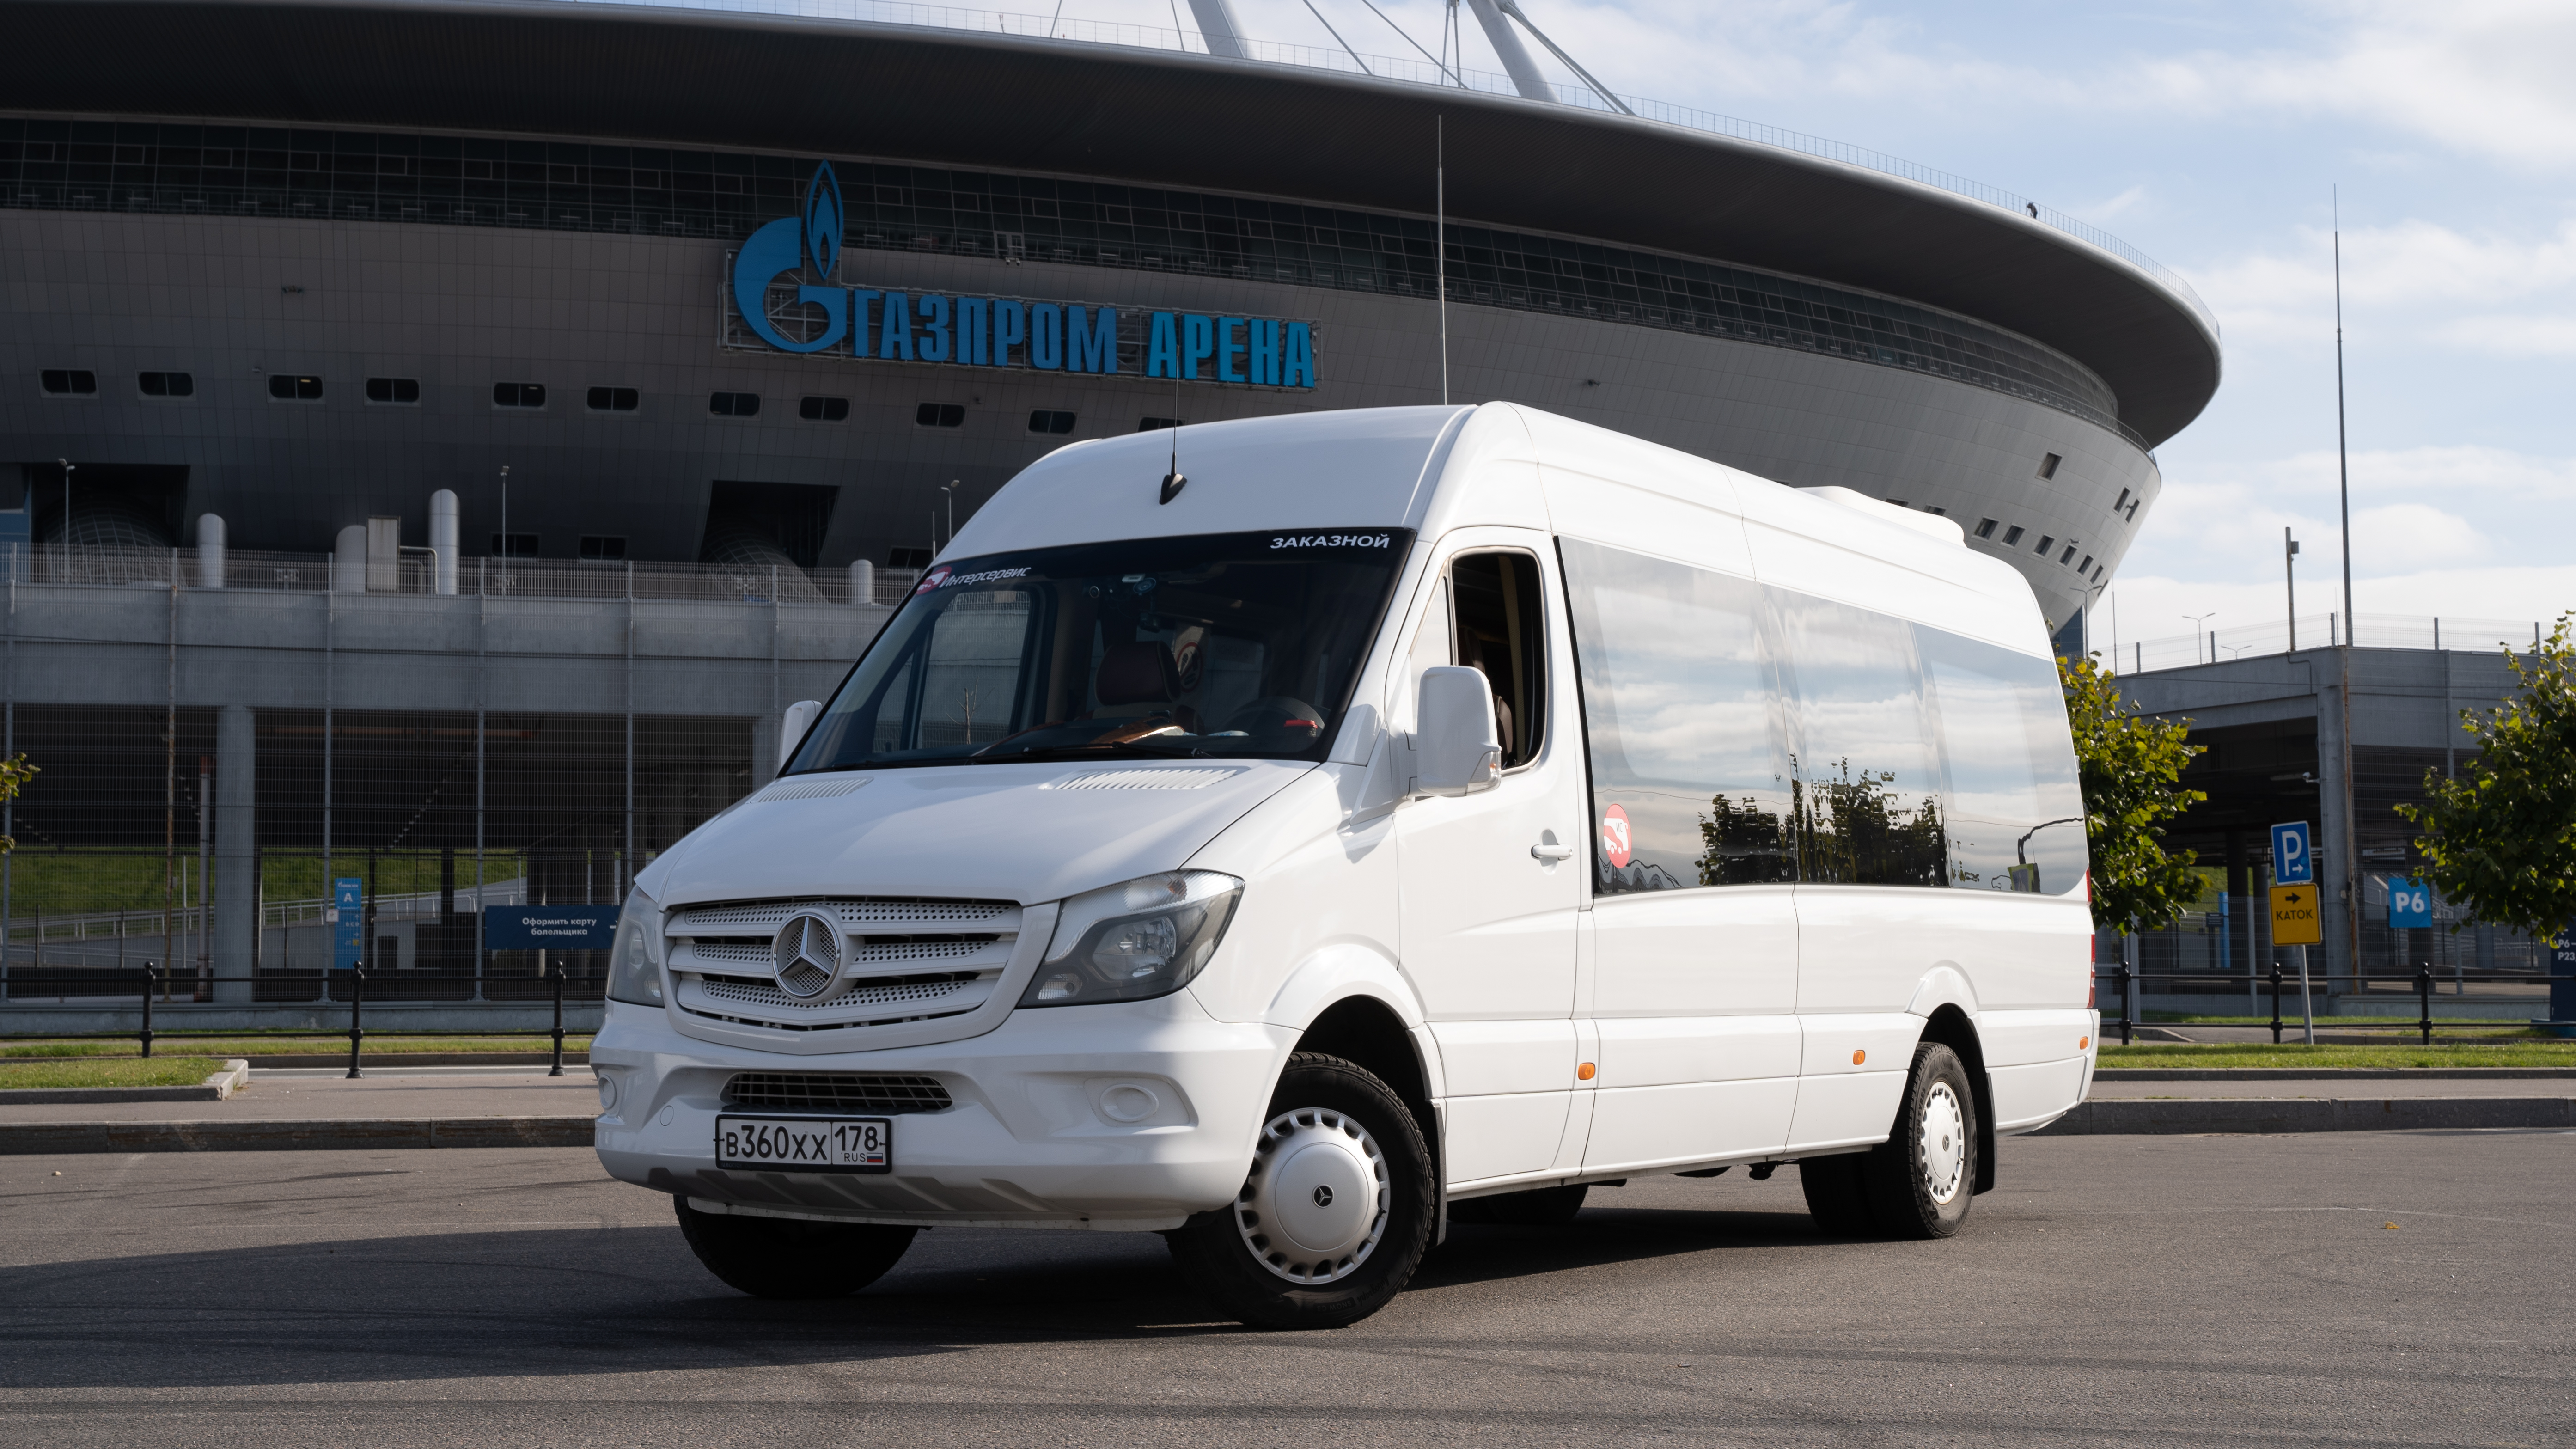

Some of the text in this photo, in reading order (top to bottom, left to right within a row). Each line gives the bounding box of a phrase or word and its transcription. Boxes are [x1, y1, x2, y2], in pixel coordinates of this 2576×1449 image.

[852, 289, 1315, 388] ГАЗПРОМ АРЕНА
[1270, 533, 1390, 549] ЗАКАЗНОЙ
[939, 567, 1032, 588] Интерсервис
[2282, 831, 2302, 876] P
[343, 892, 353, 902] A
[2395, 892, 2424, 913] P6
[522, 917, 568, 926] Оформить
[2276, 909, 2313, 921] КАТОК
[531, 928, 587, 936] болельщика
[1918, 1087, 1926, 1117] TYRES
[834, 1125, 878, 1151] 178
[844, 1153, 866, 1162] RUS
[1330, 1300, 1352, 1311] SNOW
